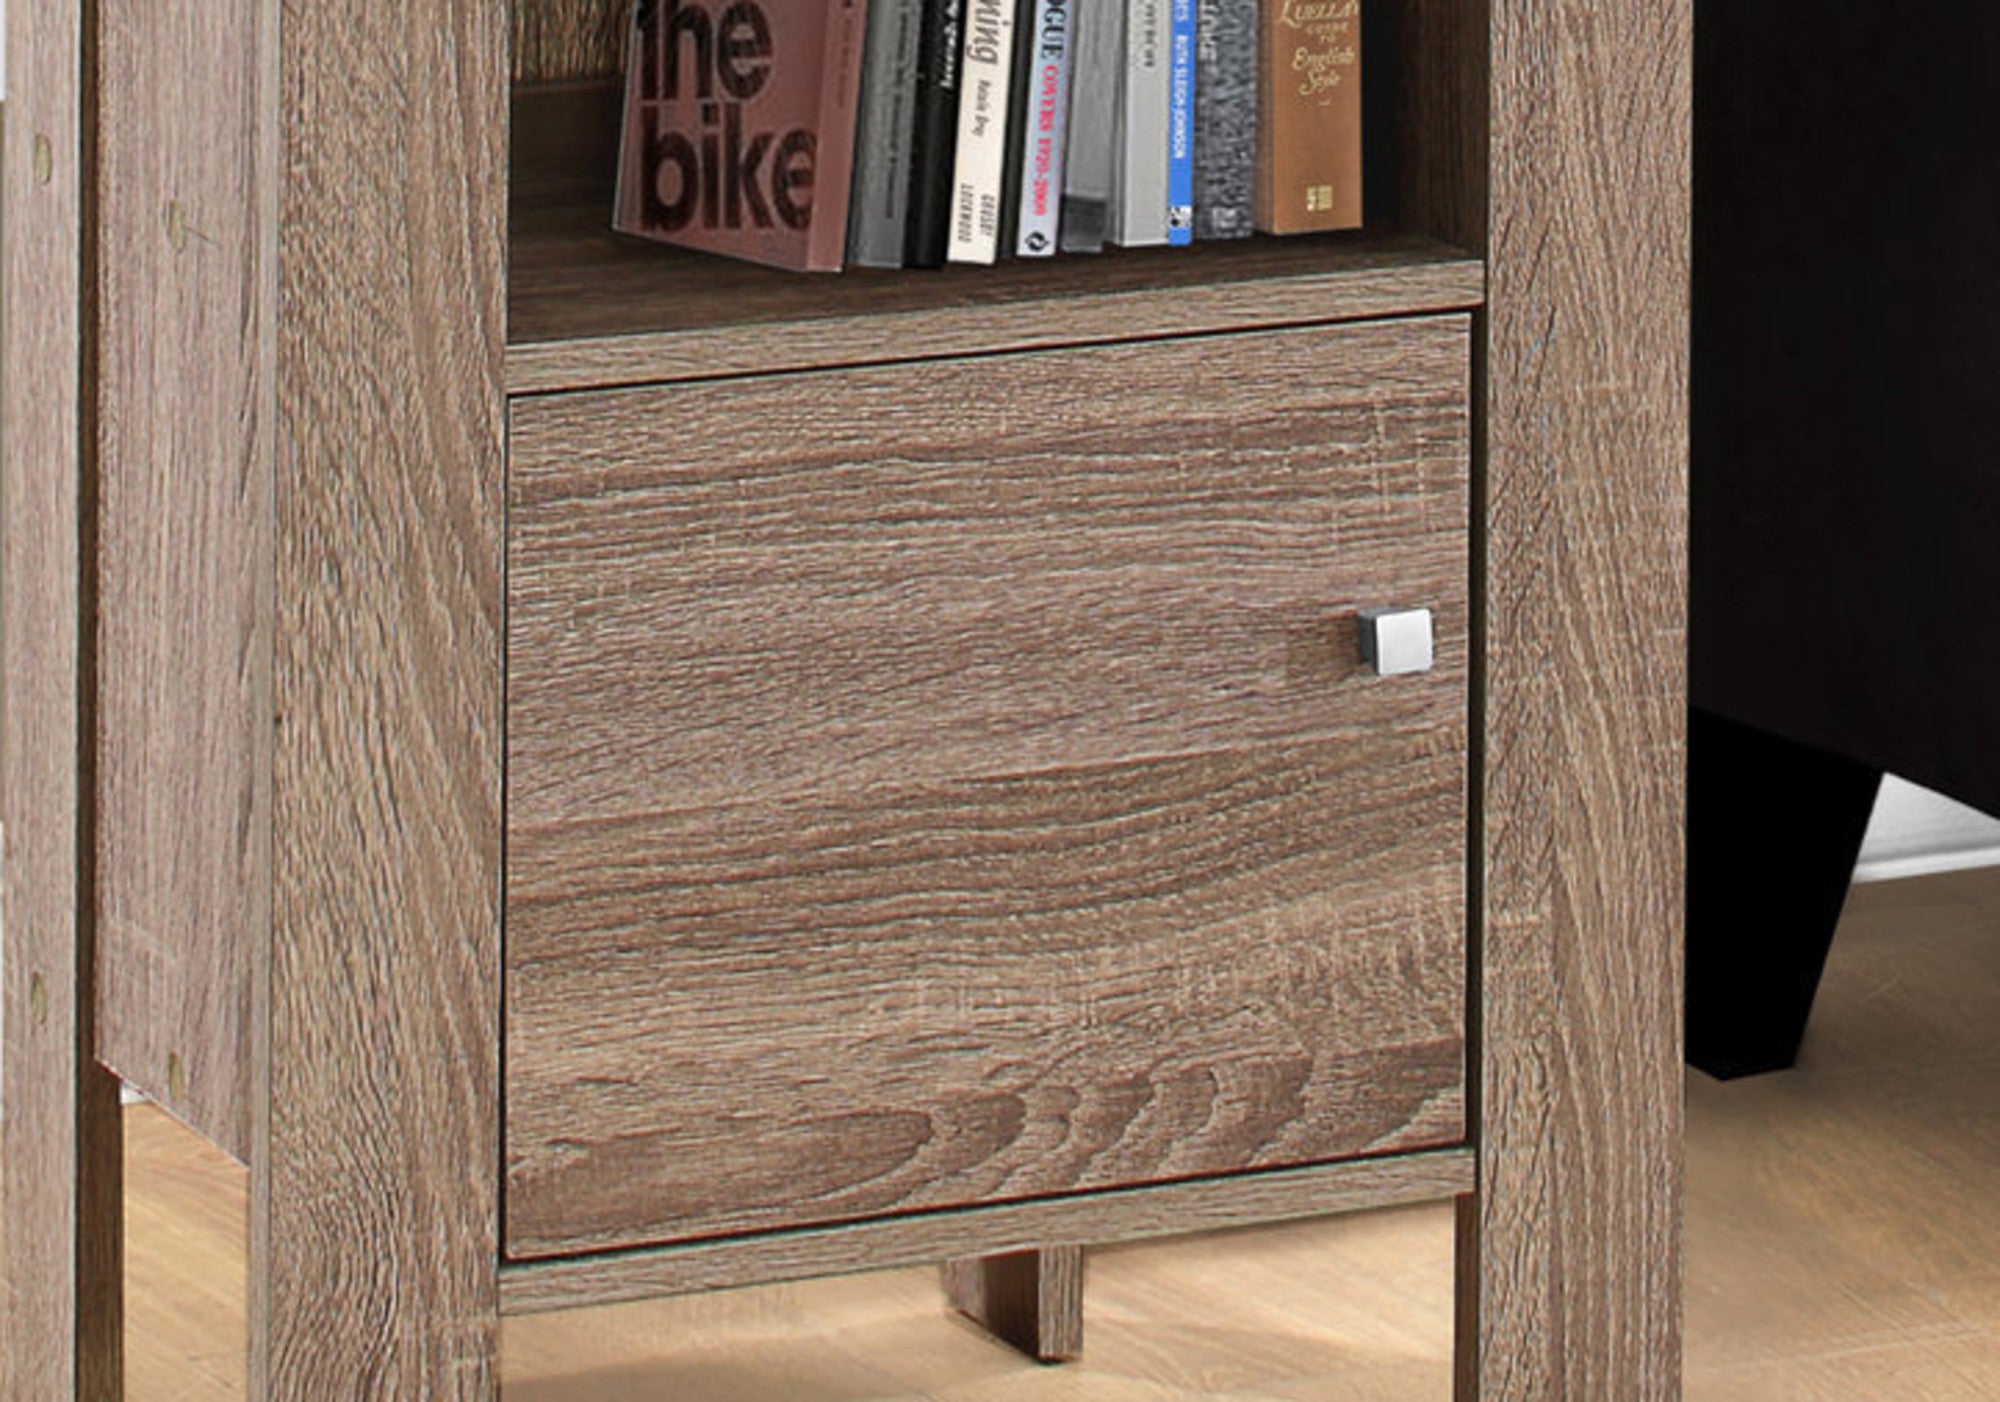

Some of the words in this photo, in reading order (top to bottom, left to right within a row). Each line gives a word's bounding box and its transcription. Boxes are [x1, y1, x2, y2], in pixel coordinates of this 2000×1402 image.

[637, 0, 773, 99] the
[1038, 64, 1059, 132] COVERS
[641, 102, 817, 233] bike
